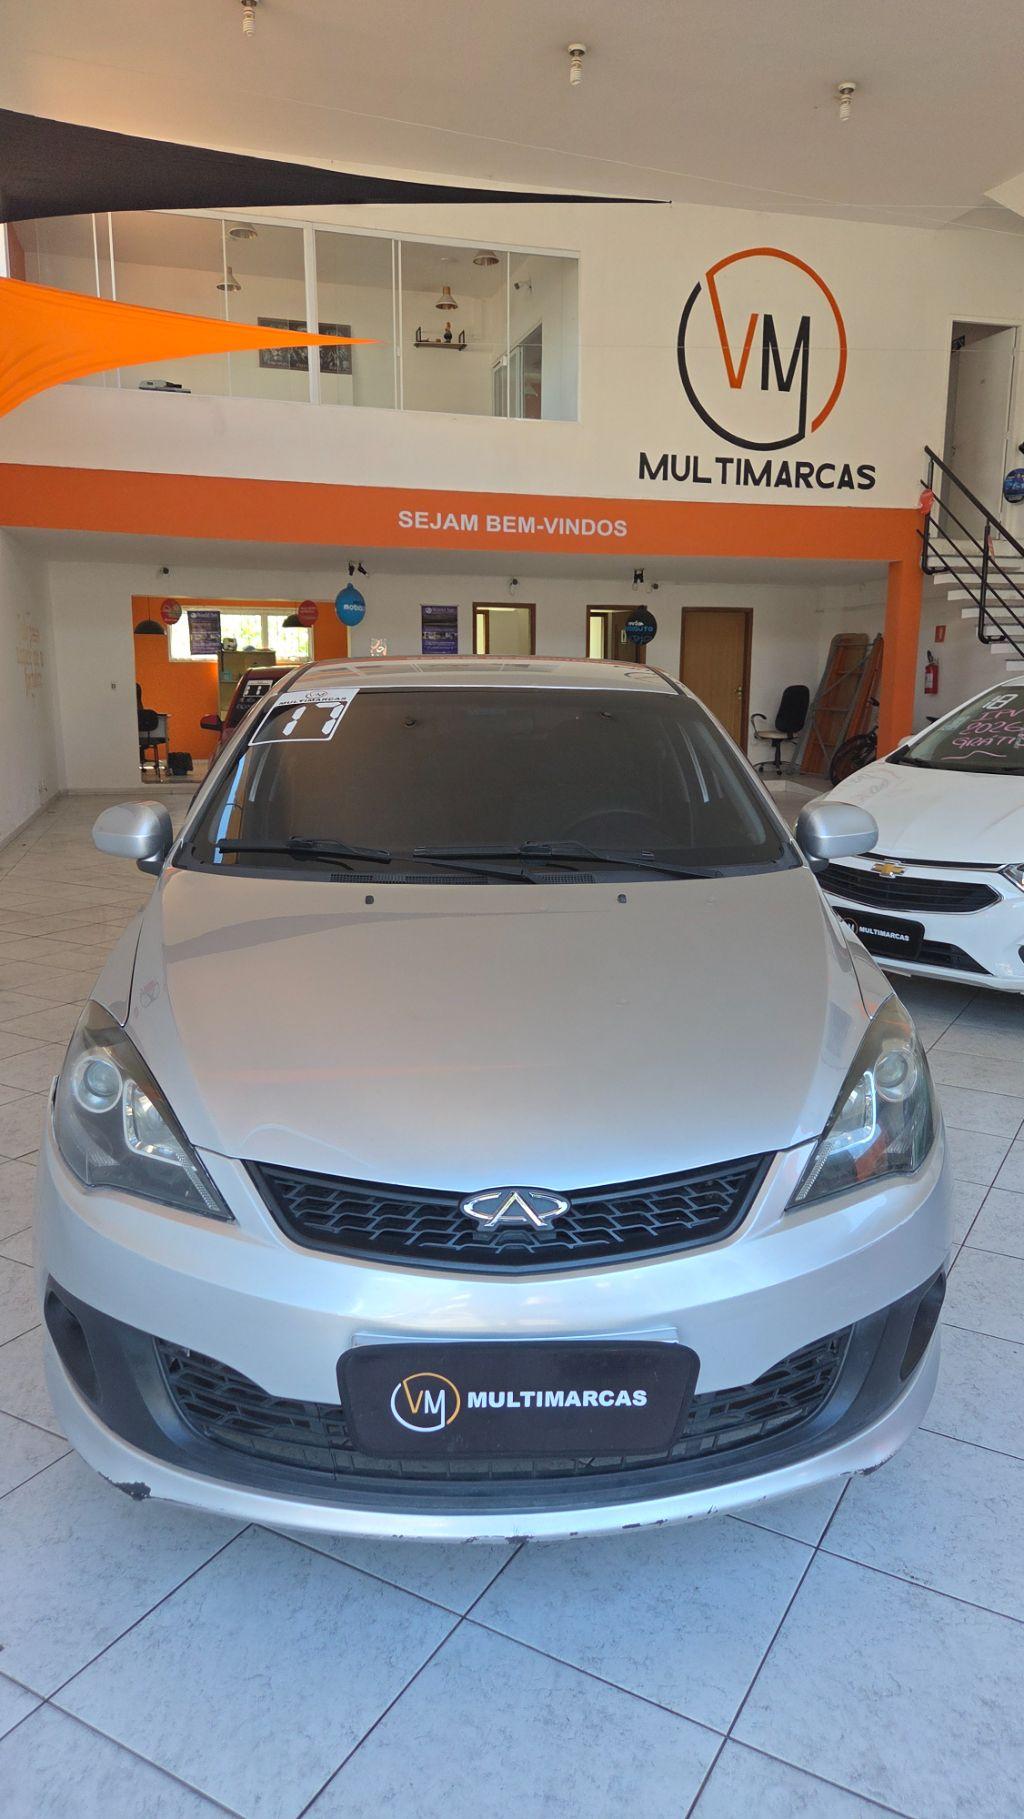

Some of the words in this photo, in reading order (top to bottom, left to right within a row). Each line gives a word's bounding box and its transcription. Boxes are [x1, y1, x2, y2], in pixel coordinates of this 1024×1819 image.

[638, 451, 876, 491] MULTIMARCAS
[397, 510, 479, 532] SEJAM
[485, 514, 628, 538] BEM-VINDOS
[279, 696, 348, 706] MULTIMARCAS
[981, 693, 1019, 709] 18
[282, 701, 345, 737] 17
[858, 926, 910, 942] MULTIMARCAS
[467, 1389, 648, 1409] MULTIMARCAS
